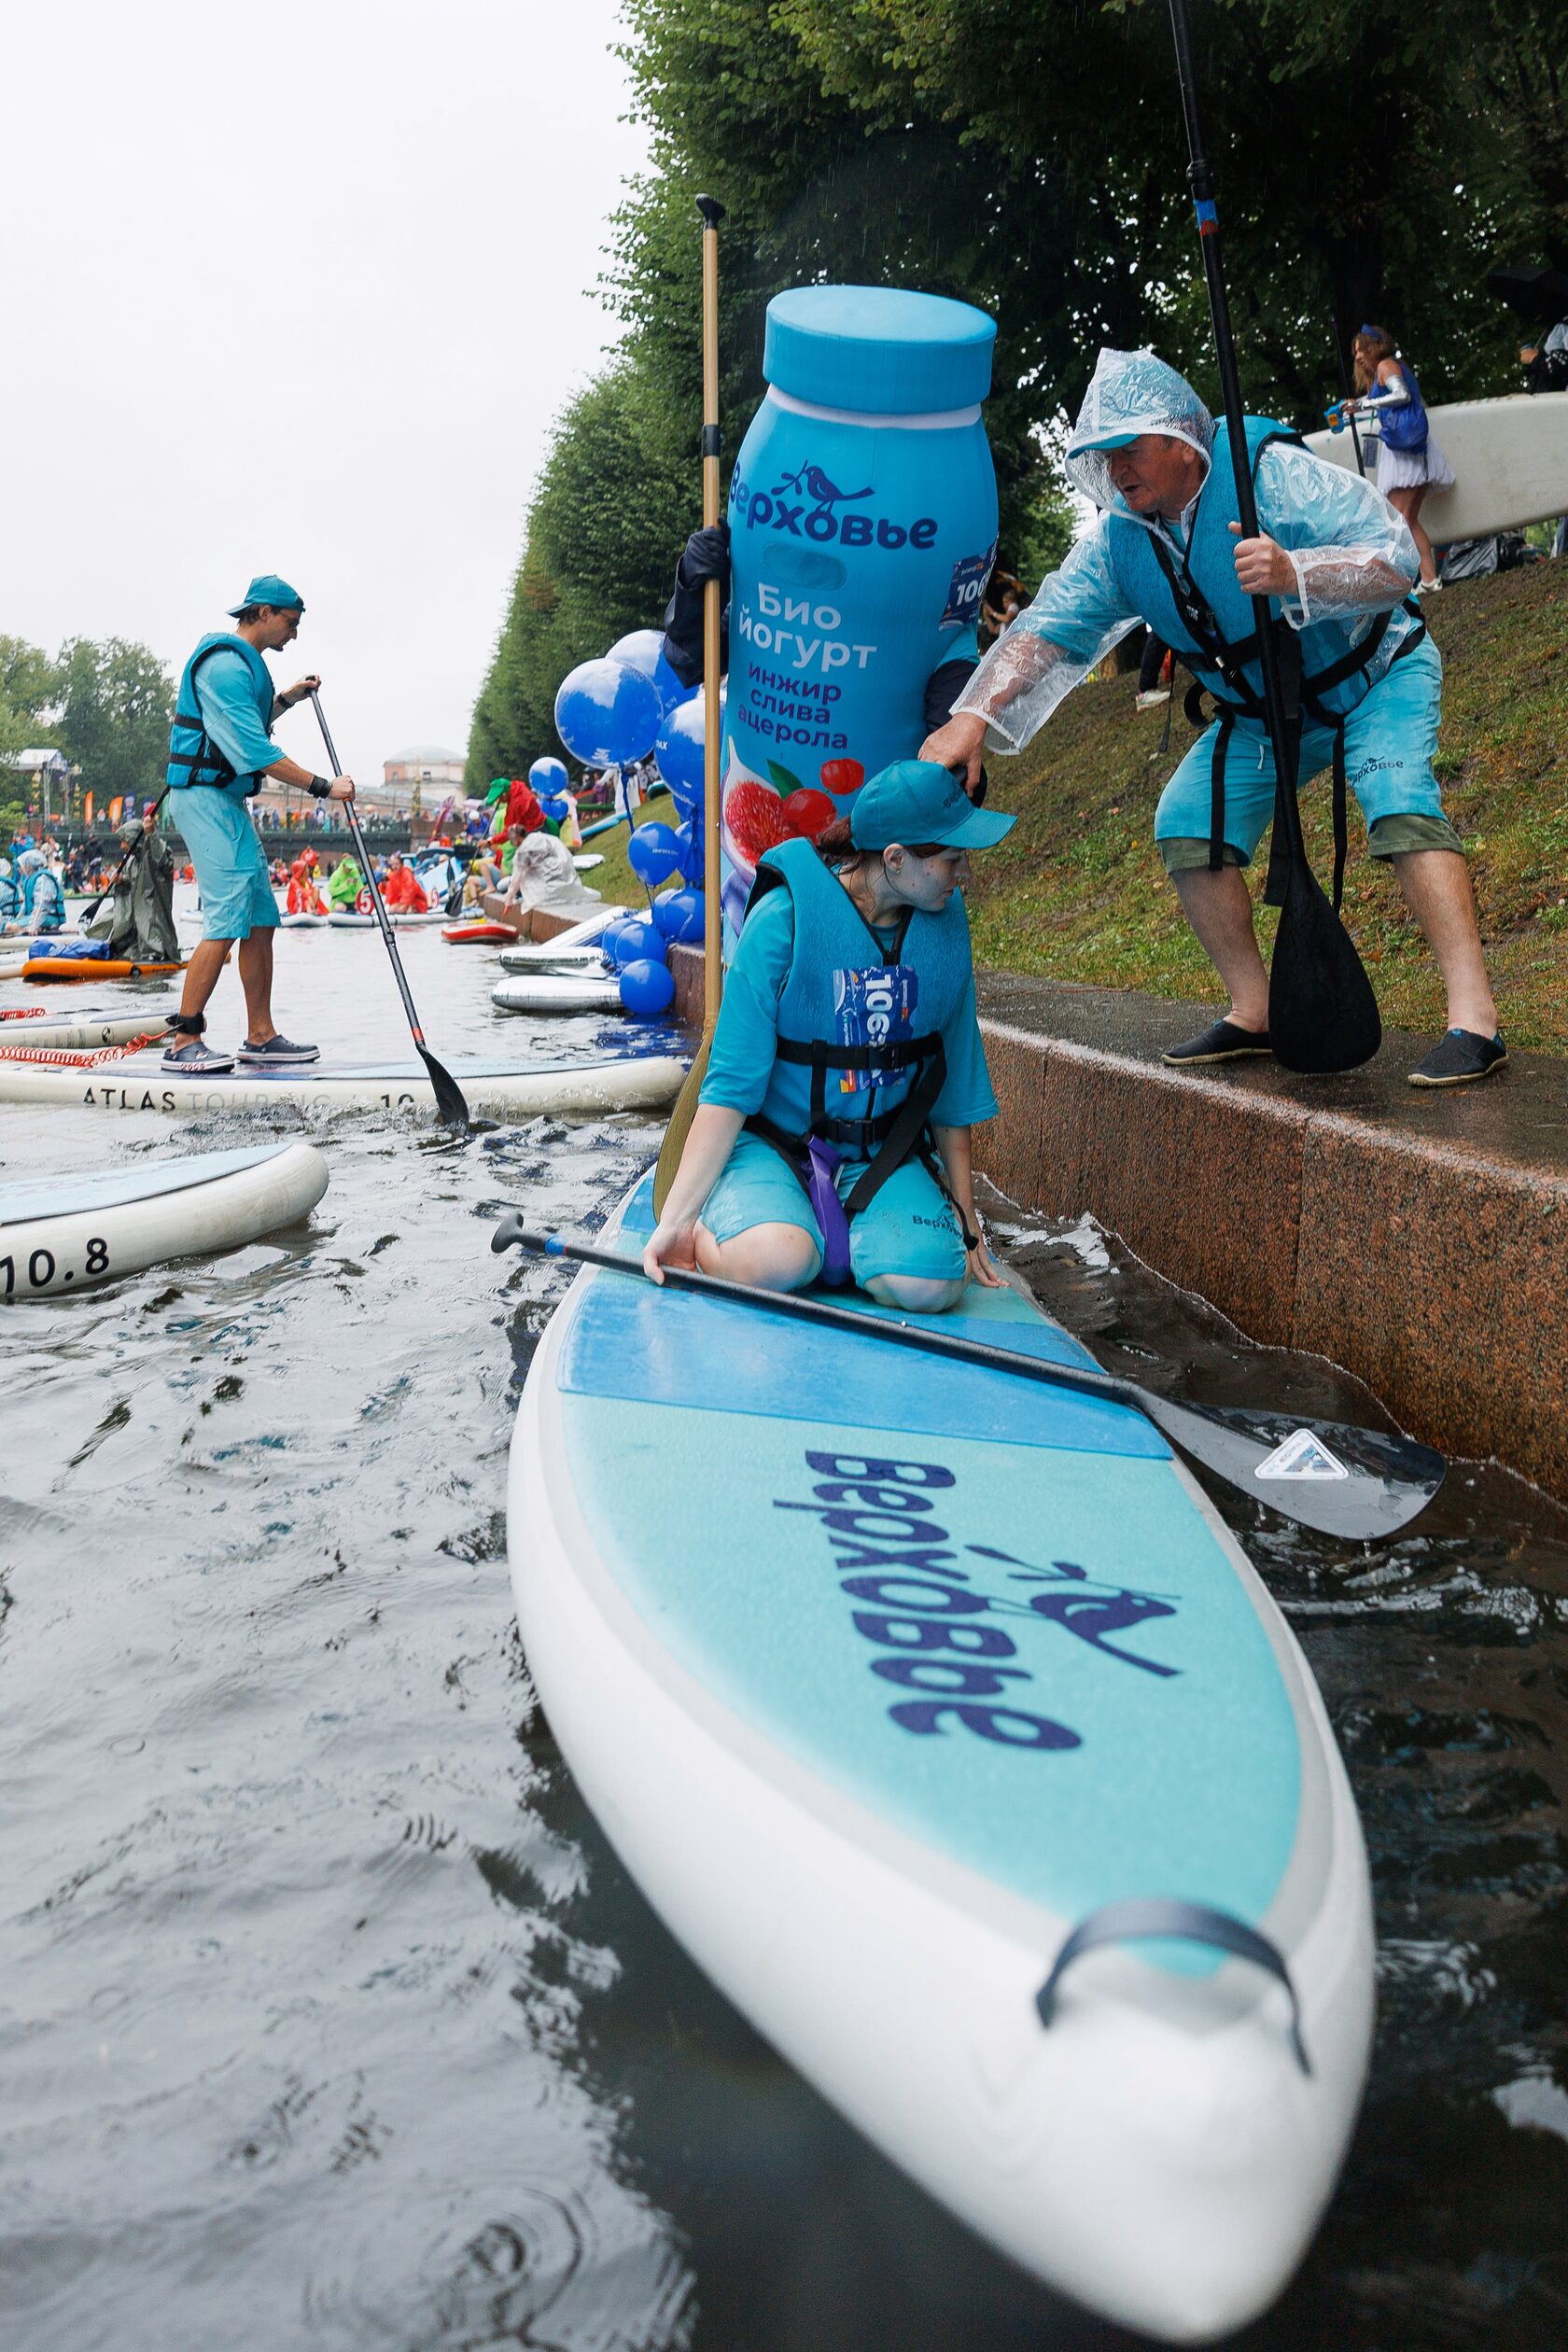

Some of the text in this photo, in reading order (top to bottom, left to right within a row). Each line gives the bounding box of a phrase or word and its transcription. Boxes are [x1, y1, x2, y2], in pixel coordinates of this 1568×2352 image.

[758, 582, 842, 631] Био
[737, 605, 877, 673] йогурт
[749, 661, 842, 706] инжир
[749, 688, 832, 725] слива
[737, 703, 848, 749] ацерола
[360, 890, 371, 915] 5
[82, 1086, 176, 1113] ATLAS
[0, 1238, 109, 1295] 10.8
[773, 1449, 1083, 1751] Верховье
